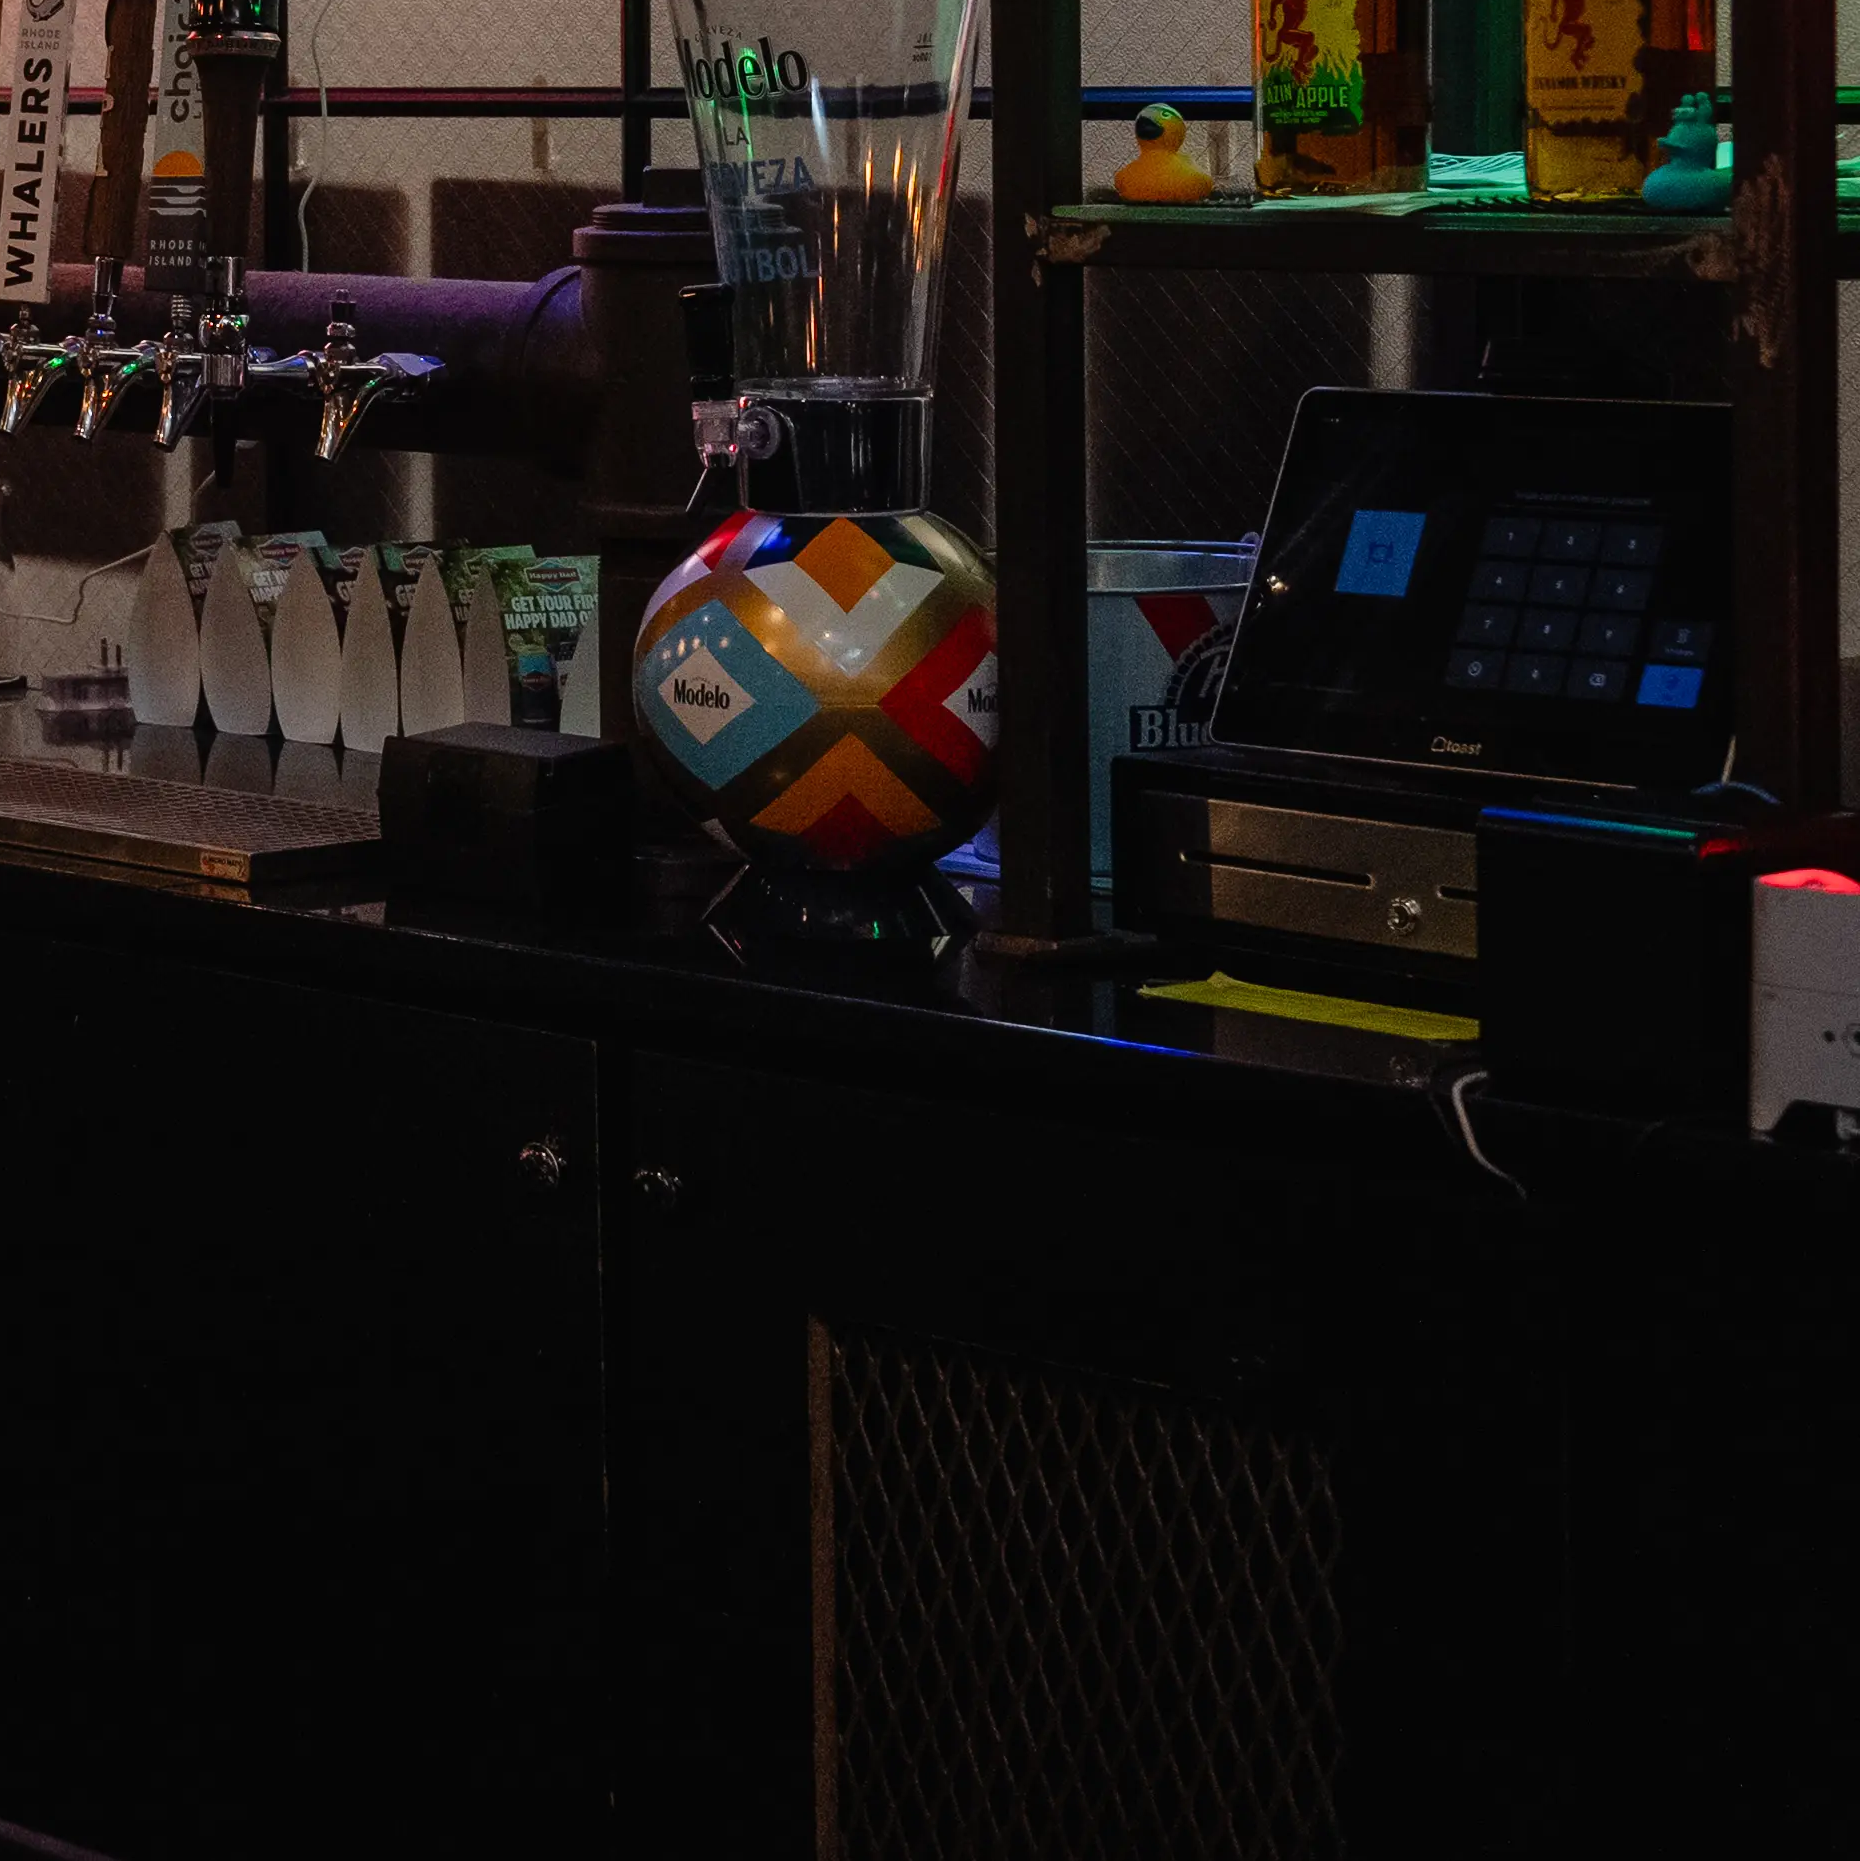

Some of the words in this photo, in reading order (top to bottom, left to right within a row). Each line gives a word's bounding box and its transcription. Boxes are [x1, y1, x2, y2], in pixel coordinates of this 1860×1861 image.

[20, 28, 61, 39] RHODE
[19, 40, 60, 51] ISLAND
[1295, 84, 1350, 109] APPLE
[723, 126, 750, 146] LA
[3, 56, 53, 289] WHALERS
[149, 239, 194, 251] RHODE
[147, 254, 193, 267] ISLAND
[528, 570, 559, 581] Happy
[559, 570, 578, 579] Dad
[511, 595, 536, 612] GET
[538, 594, 573, 611] YOUR
[504, 612, 549, 631] HAPPY
[550, 610, 578, 629] DAD
[673, 677, 731, 711] Modelo
[967, 688, 999, 715] Mod
[1444, 740, 1483, 756] toast
